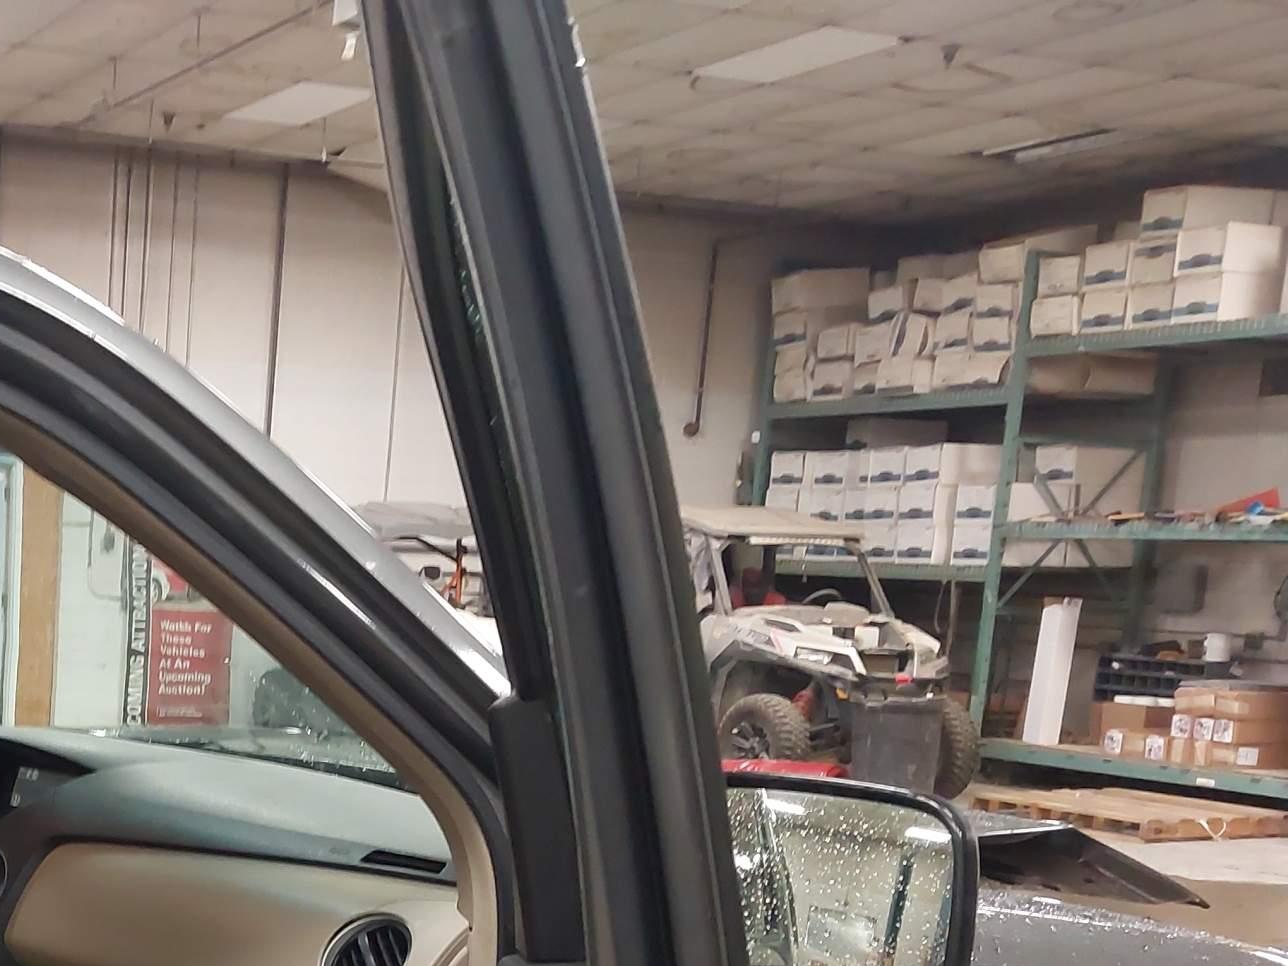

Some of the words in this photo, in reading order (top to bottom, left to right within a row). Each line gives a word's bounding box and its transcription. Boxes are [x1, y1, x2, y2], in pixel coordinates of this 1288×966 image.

[160, 619, 192, 633] Watch
[194, 621, 212, 633] For
[160, 632, 192, 645] These
[160, 643, 205, 658] Vehicles
[159, 658, 172, 670] At
[174, 658, 190, 670] An
[158, 670, 212, 684] Upcoming
[126, 655, 144, 726] COMING
[158, 683, 206, 696] Auction!
